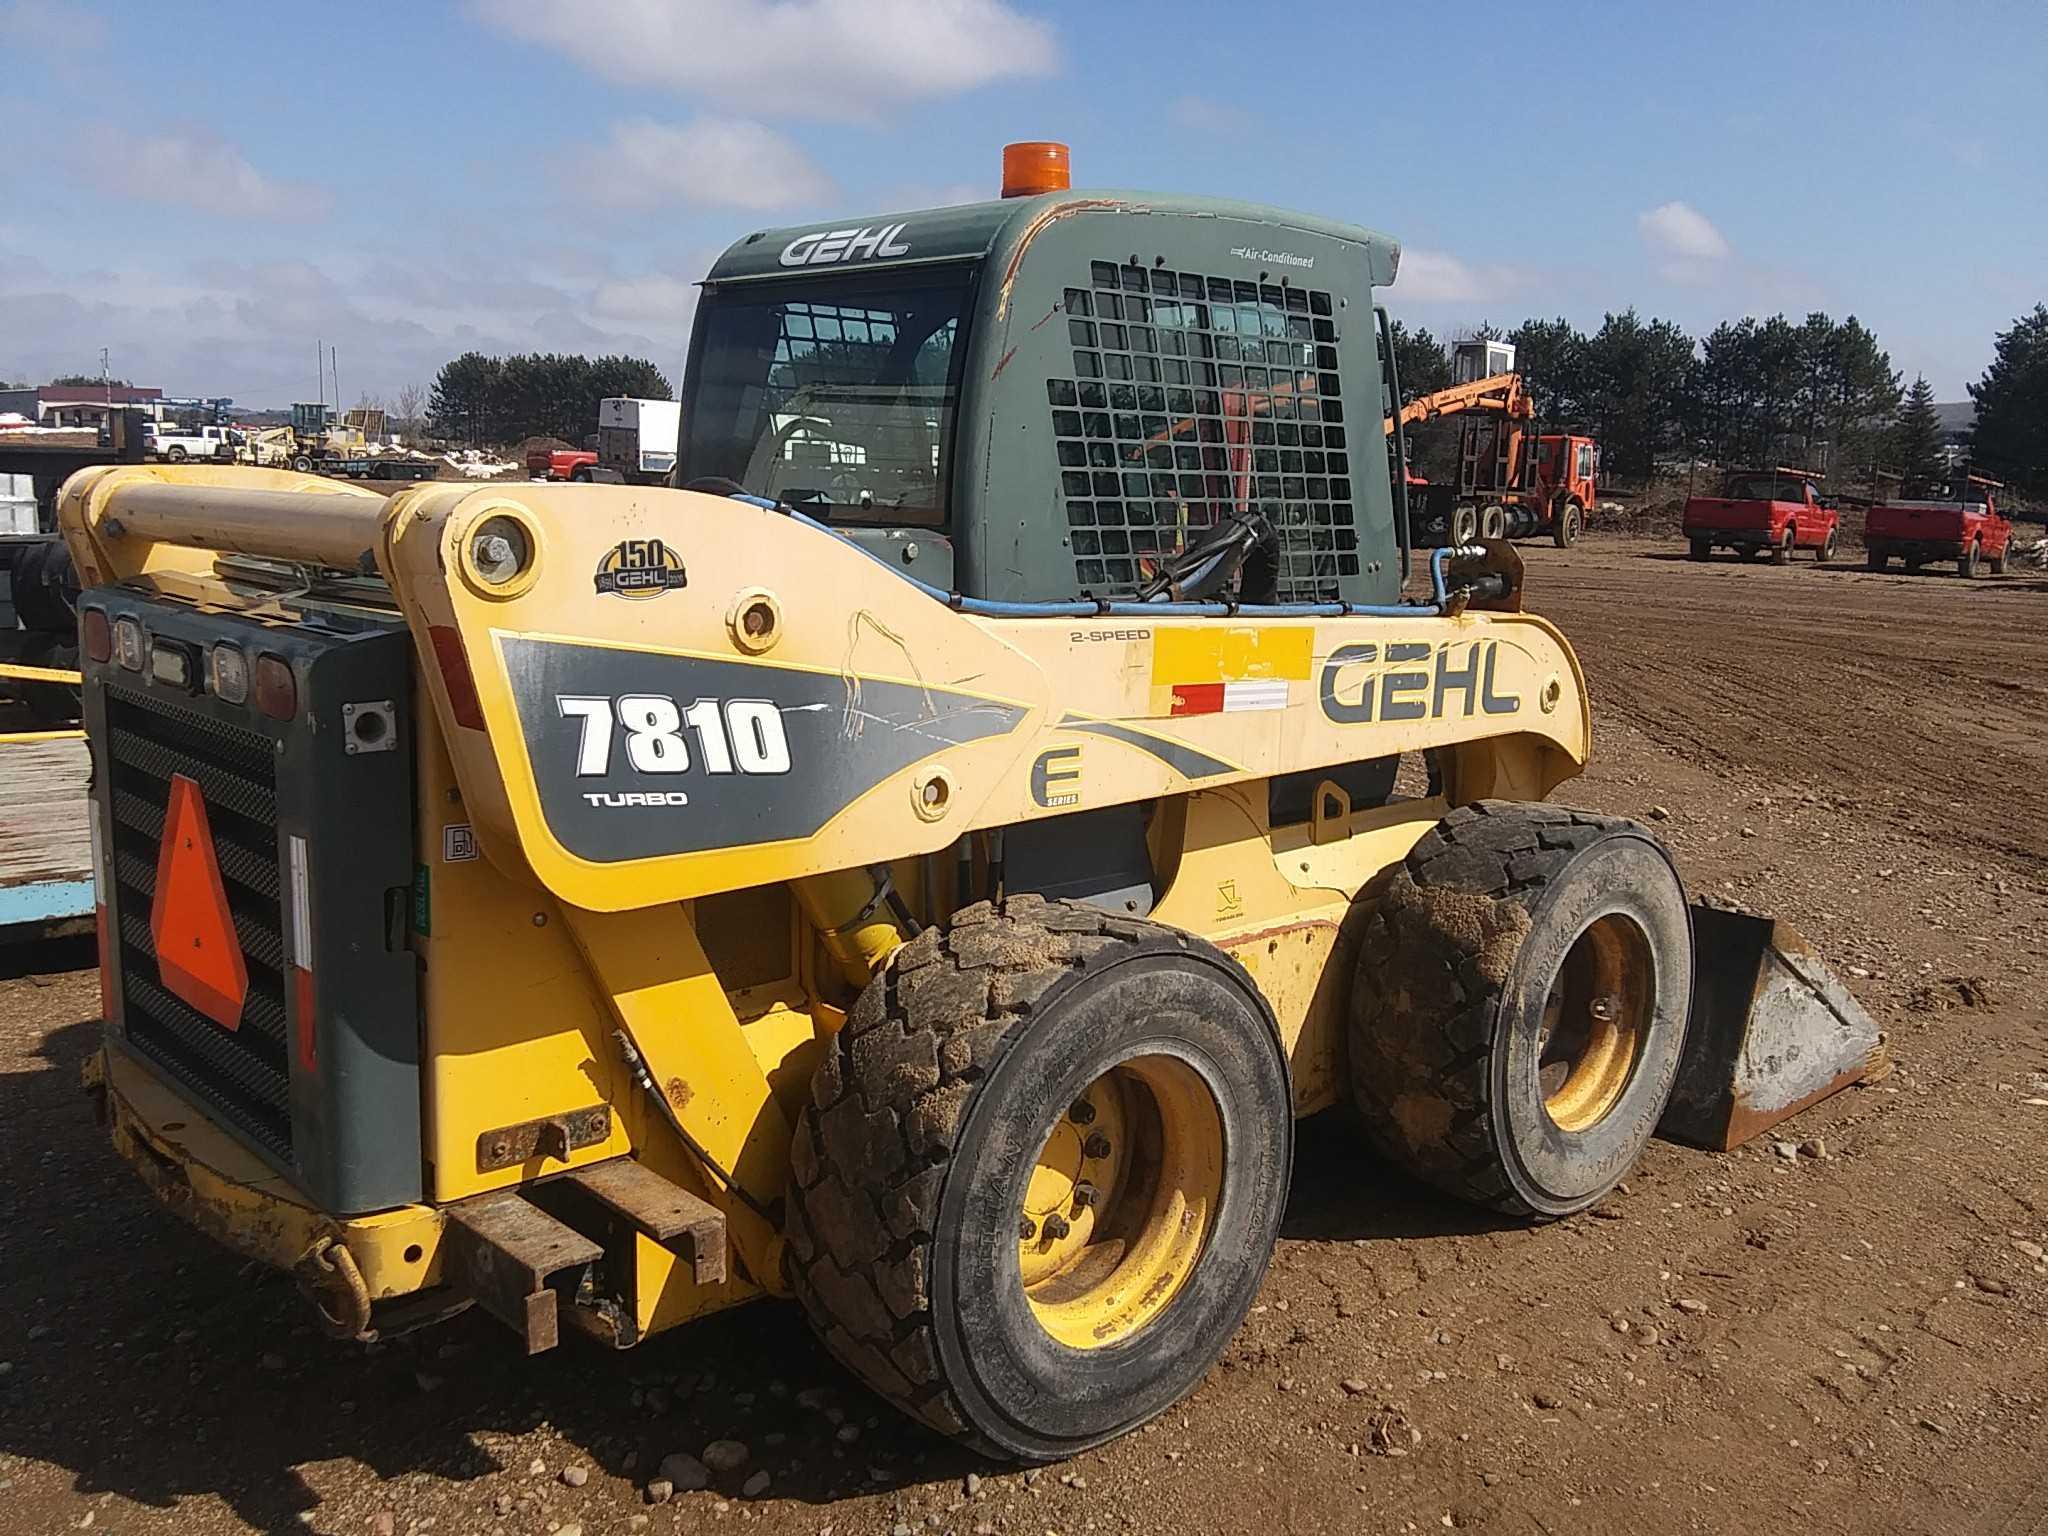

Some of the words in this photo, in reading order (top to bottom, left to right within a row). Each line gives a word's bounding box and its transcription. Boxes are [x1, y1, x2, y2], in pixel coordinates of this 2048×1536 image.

[778, 221, 912, 267] GEHL
[1244, 247, 1315, 269] Air-Conditioned
[619, 538, 664, 568] 150
[616, 570, 666, 586] GEHL
[1069, 629, 1151, 643] 2-SPEED
[1319, 640, 1521, 725] GEHL
[555, 694, 792, 777] 7810
[582, 791, 689, 808] TURBO
[1047, 794, 1077, 807] SERIES
